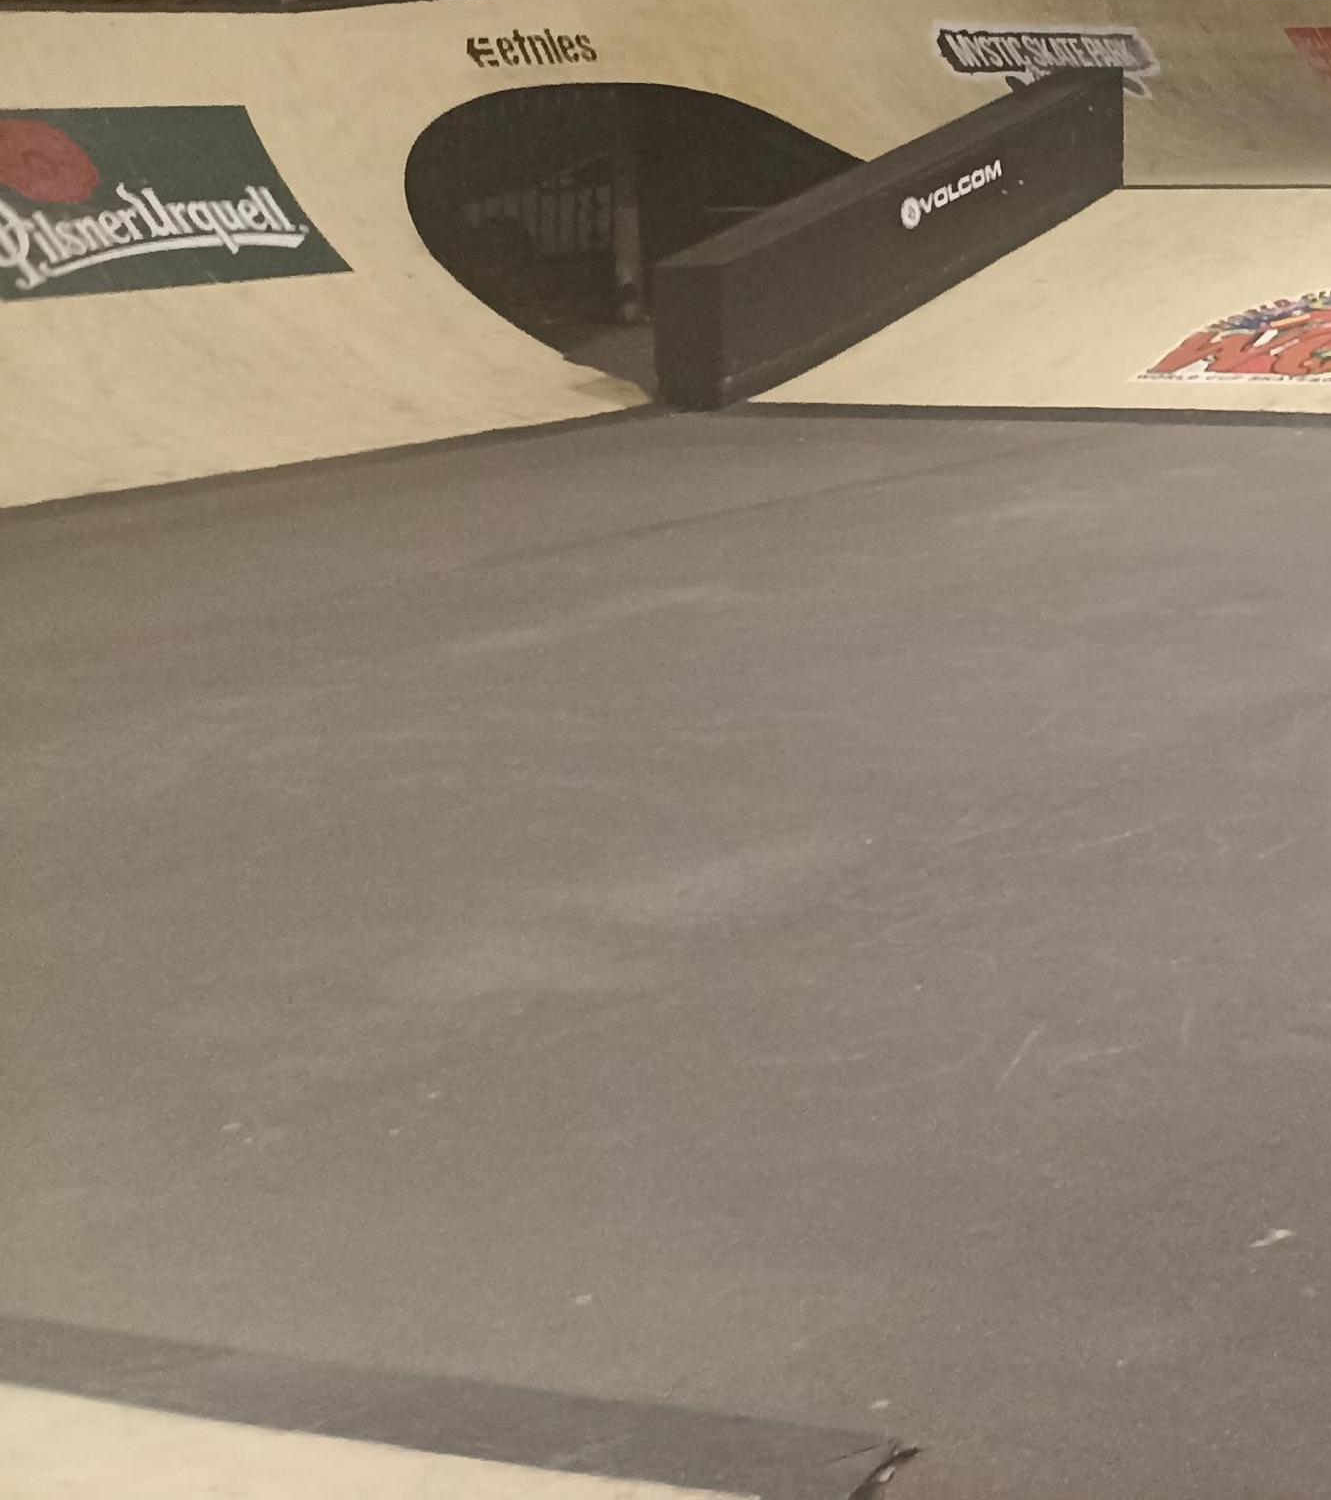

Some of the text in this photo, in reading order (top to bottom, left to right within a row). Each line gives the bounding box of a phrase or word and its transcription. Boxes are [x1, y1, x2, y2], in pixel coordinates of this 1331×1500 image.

[496, 28, 598, 66] etnies
[919, 159, 1003, 214] VOLCOM
[116, 182, 297, 255] Urquell
